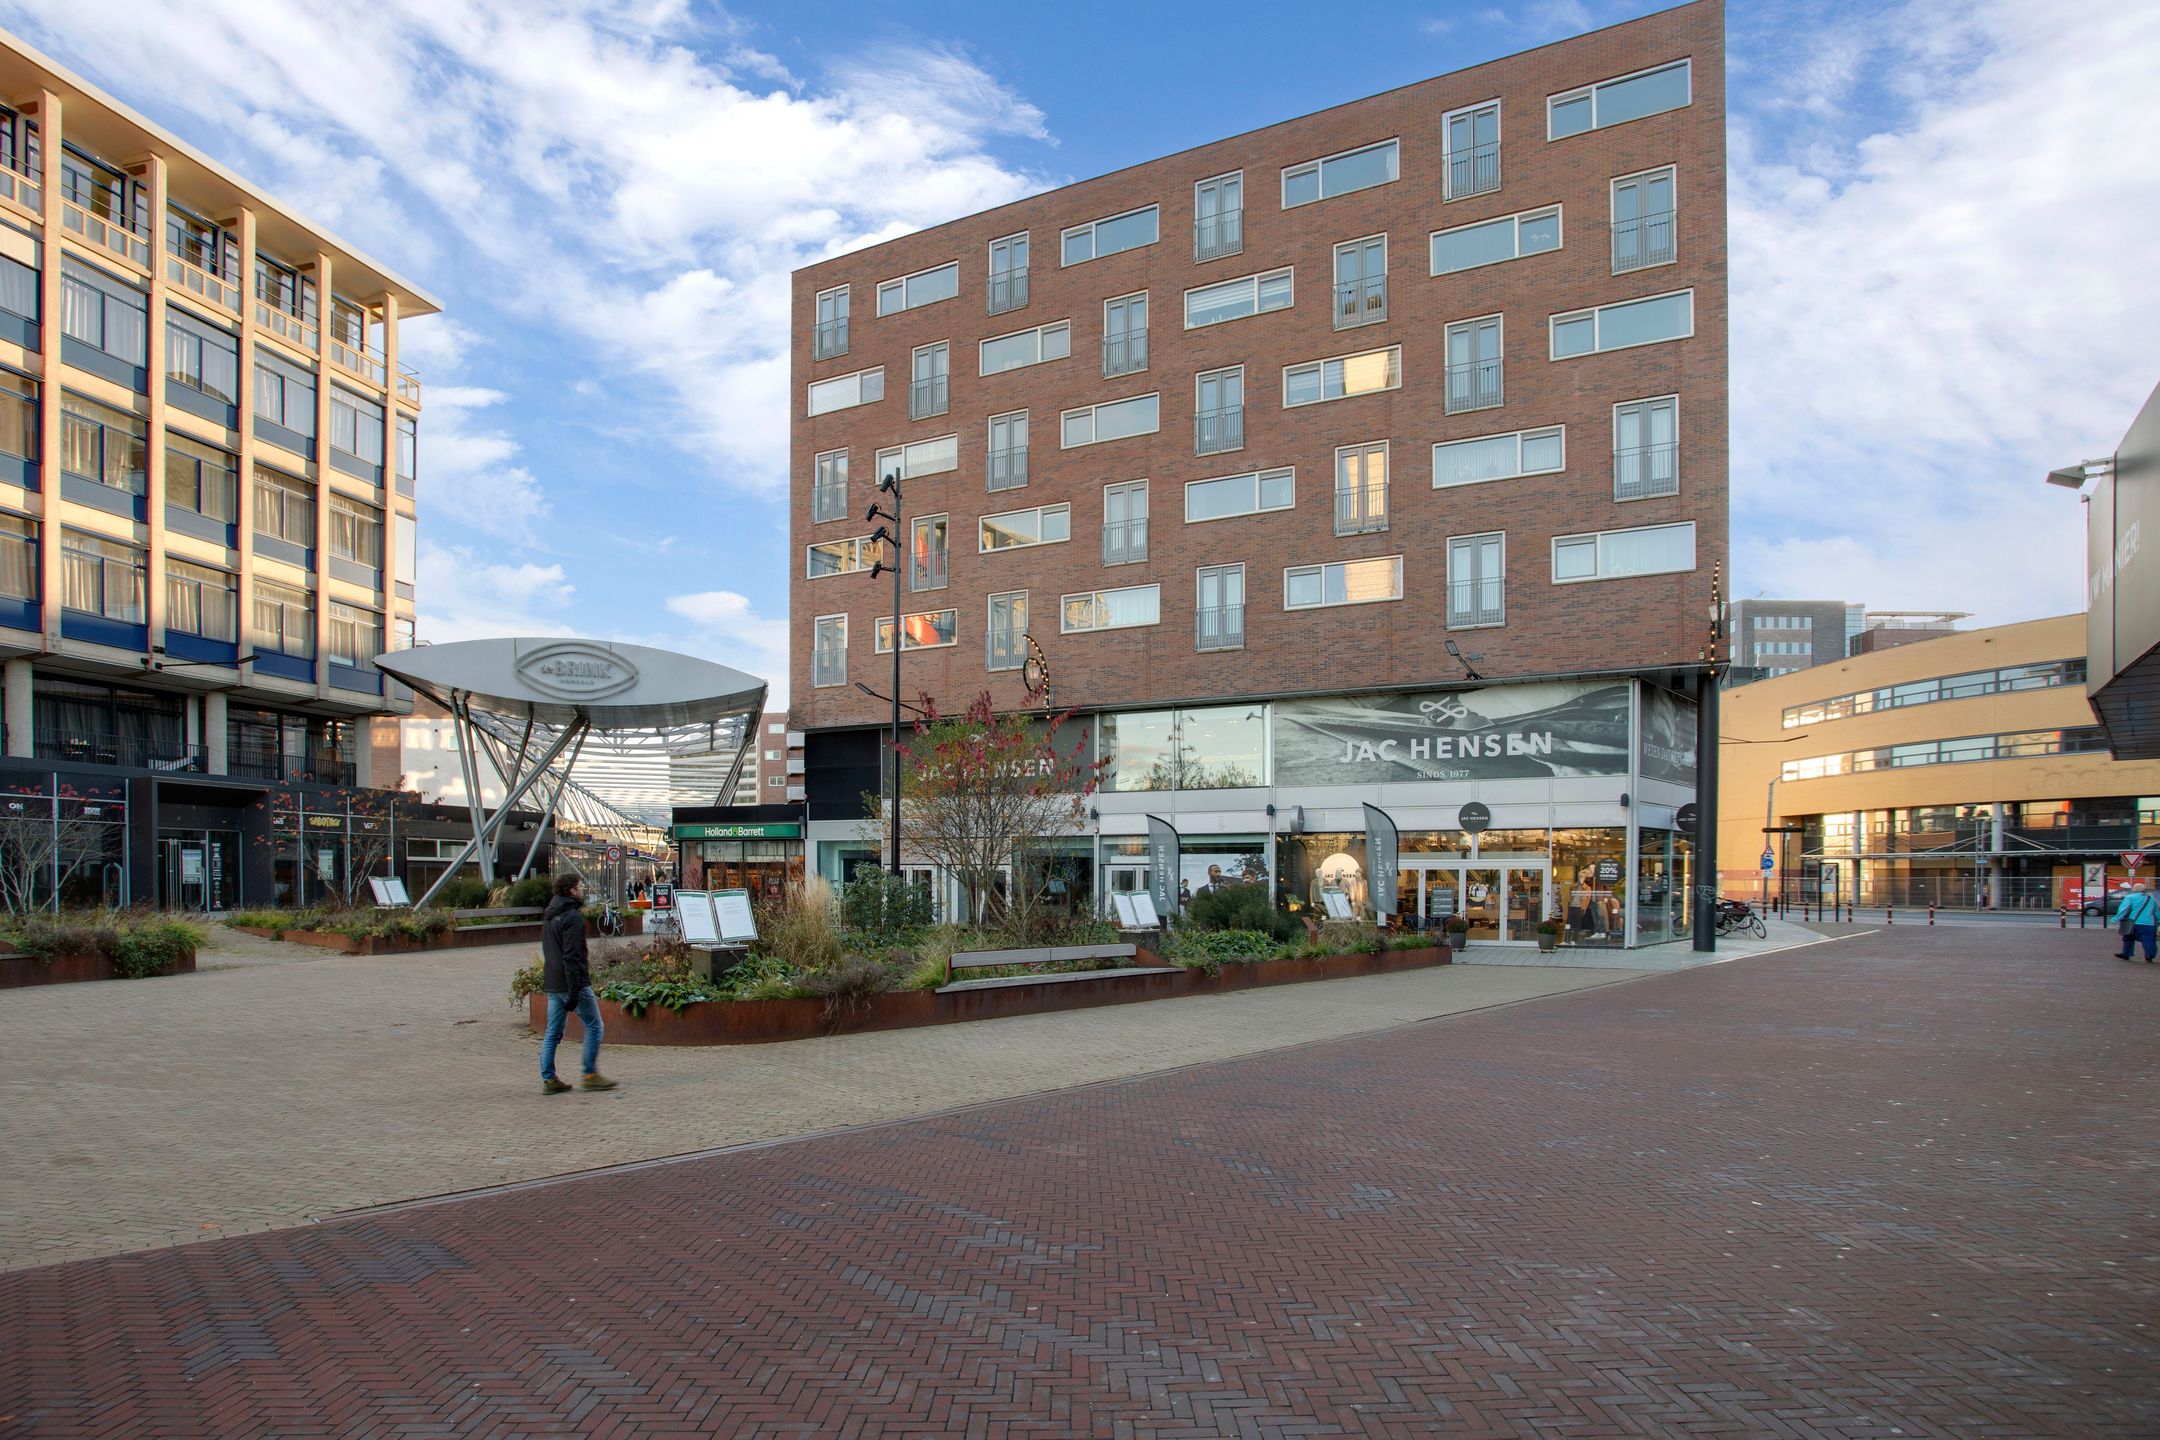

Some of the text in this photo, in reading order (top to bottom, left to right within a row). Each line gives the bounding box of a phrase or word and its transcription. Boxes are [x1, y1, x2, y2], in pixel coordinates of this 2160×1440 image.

[555, 660, 611, 679] BRINK
[1339, 731, 1552, 763] JAC HENSEN
[1417, 770, 1470, 779] SINDS 1977
[705, 827, 732, 837] Holland
[739, 827, 764, 837] Barrett
